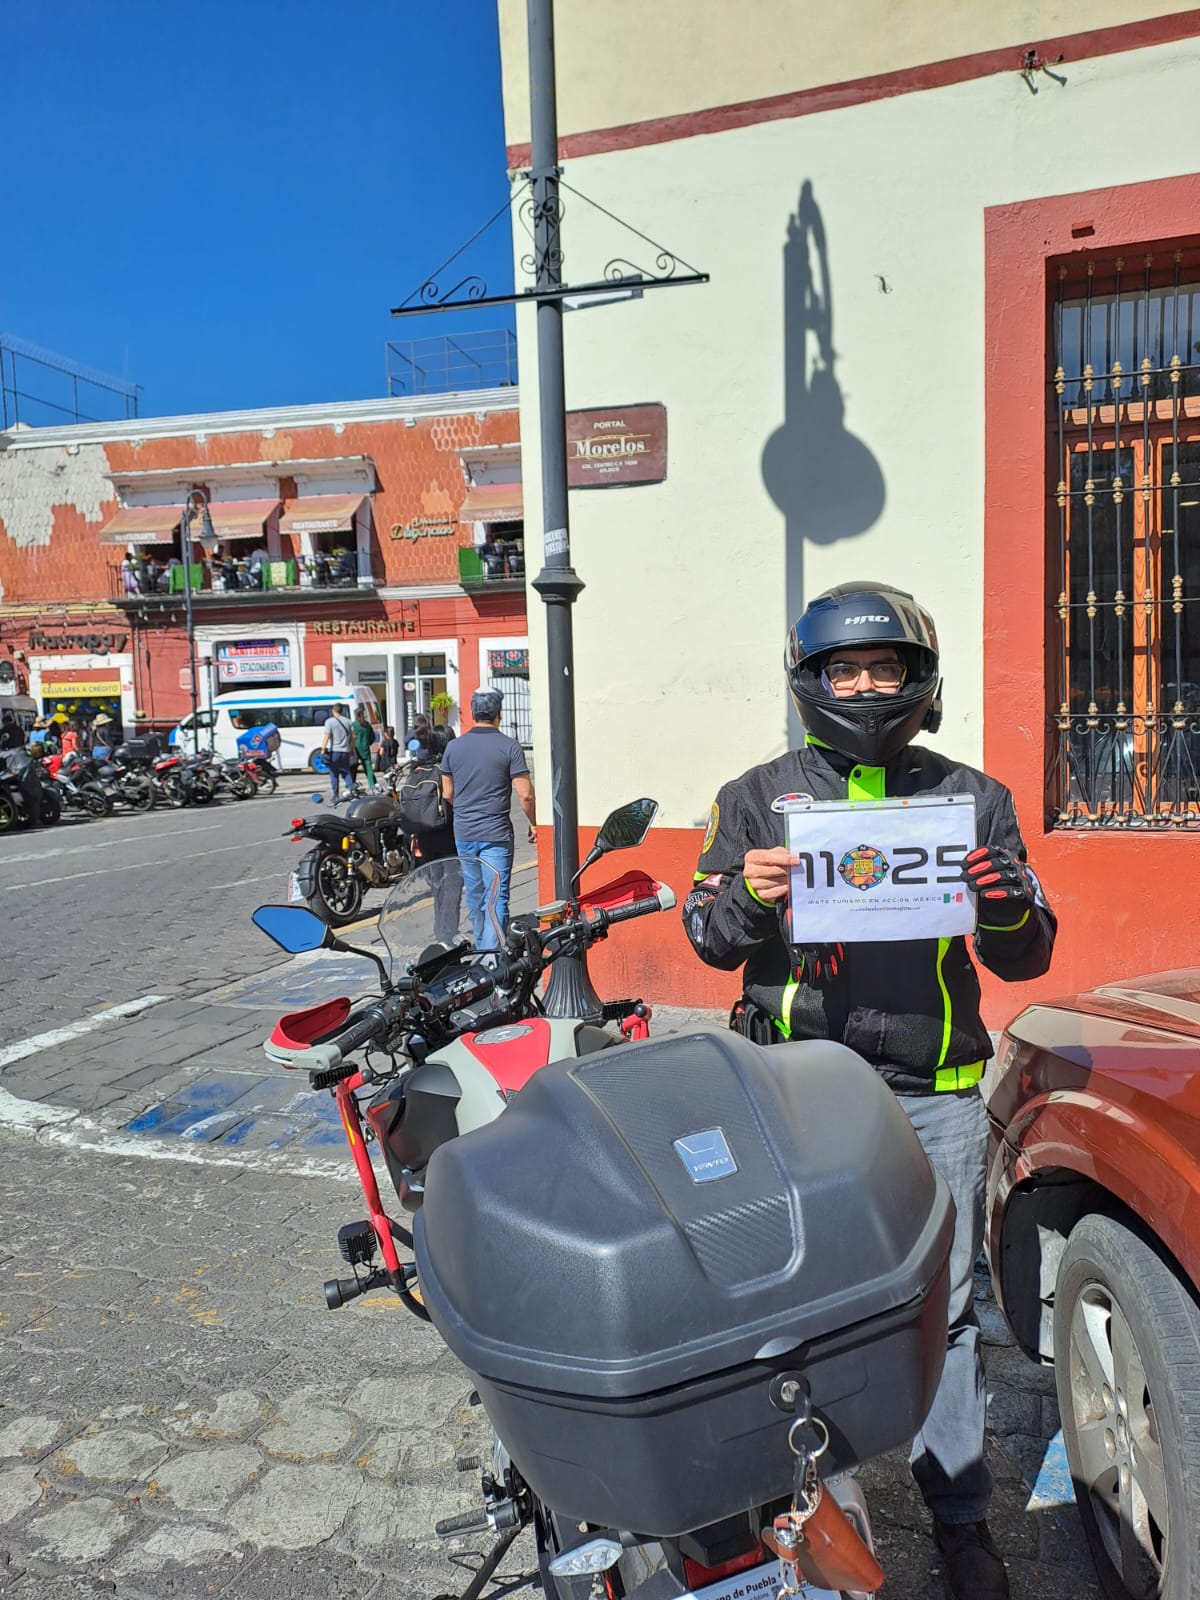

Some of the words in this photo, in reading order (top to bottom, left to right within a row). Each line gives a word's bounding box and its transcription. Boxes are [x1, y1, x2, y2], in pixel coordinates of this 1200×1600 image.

[594, 420, 626, 430] PORTAL
[576, 437, 645, 457] Morelos
[314, 620, 414, 634] RESTAURANTE
[43, 686, 80, 695] CELULARES
[733, 1588, 744, 1599] de
[746, 1576, 777, 1594] Puebla
